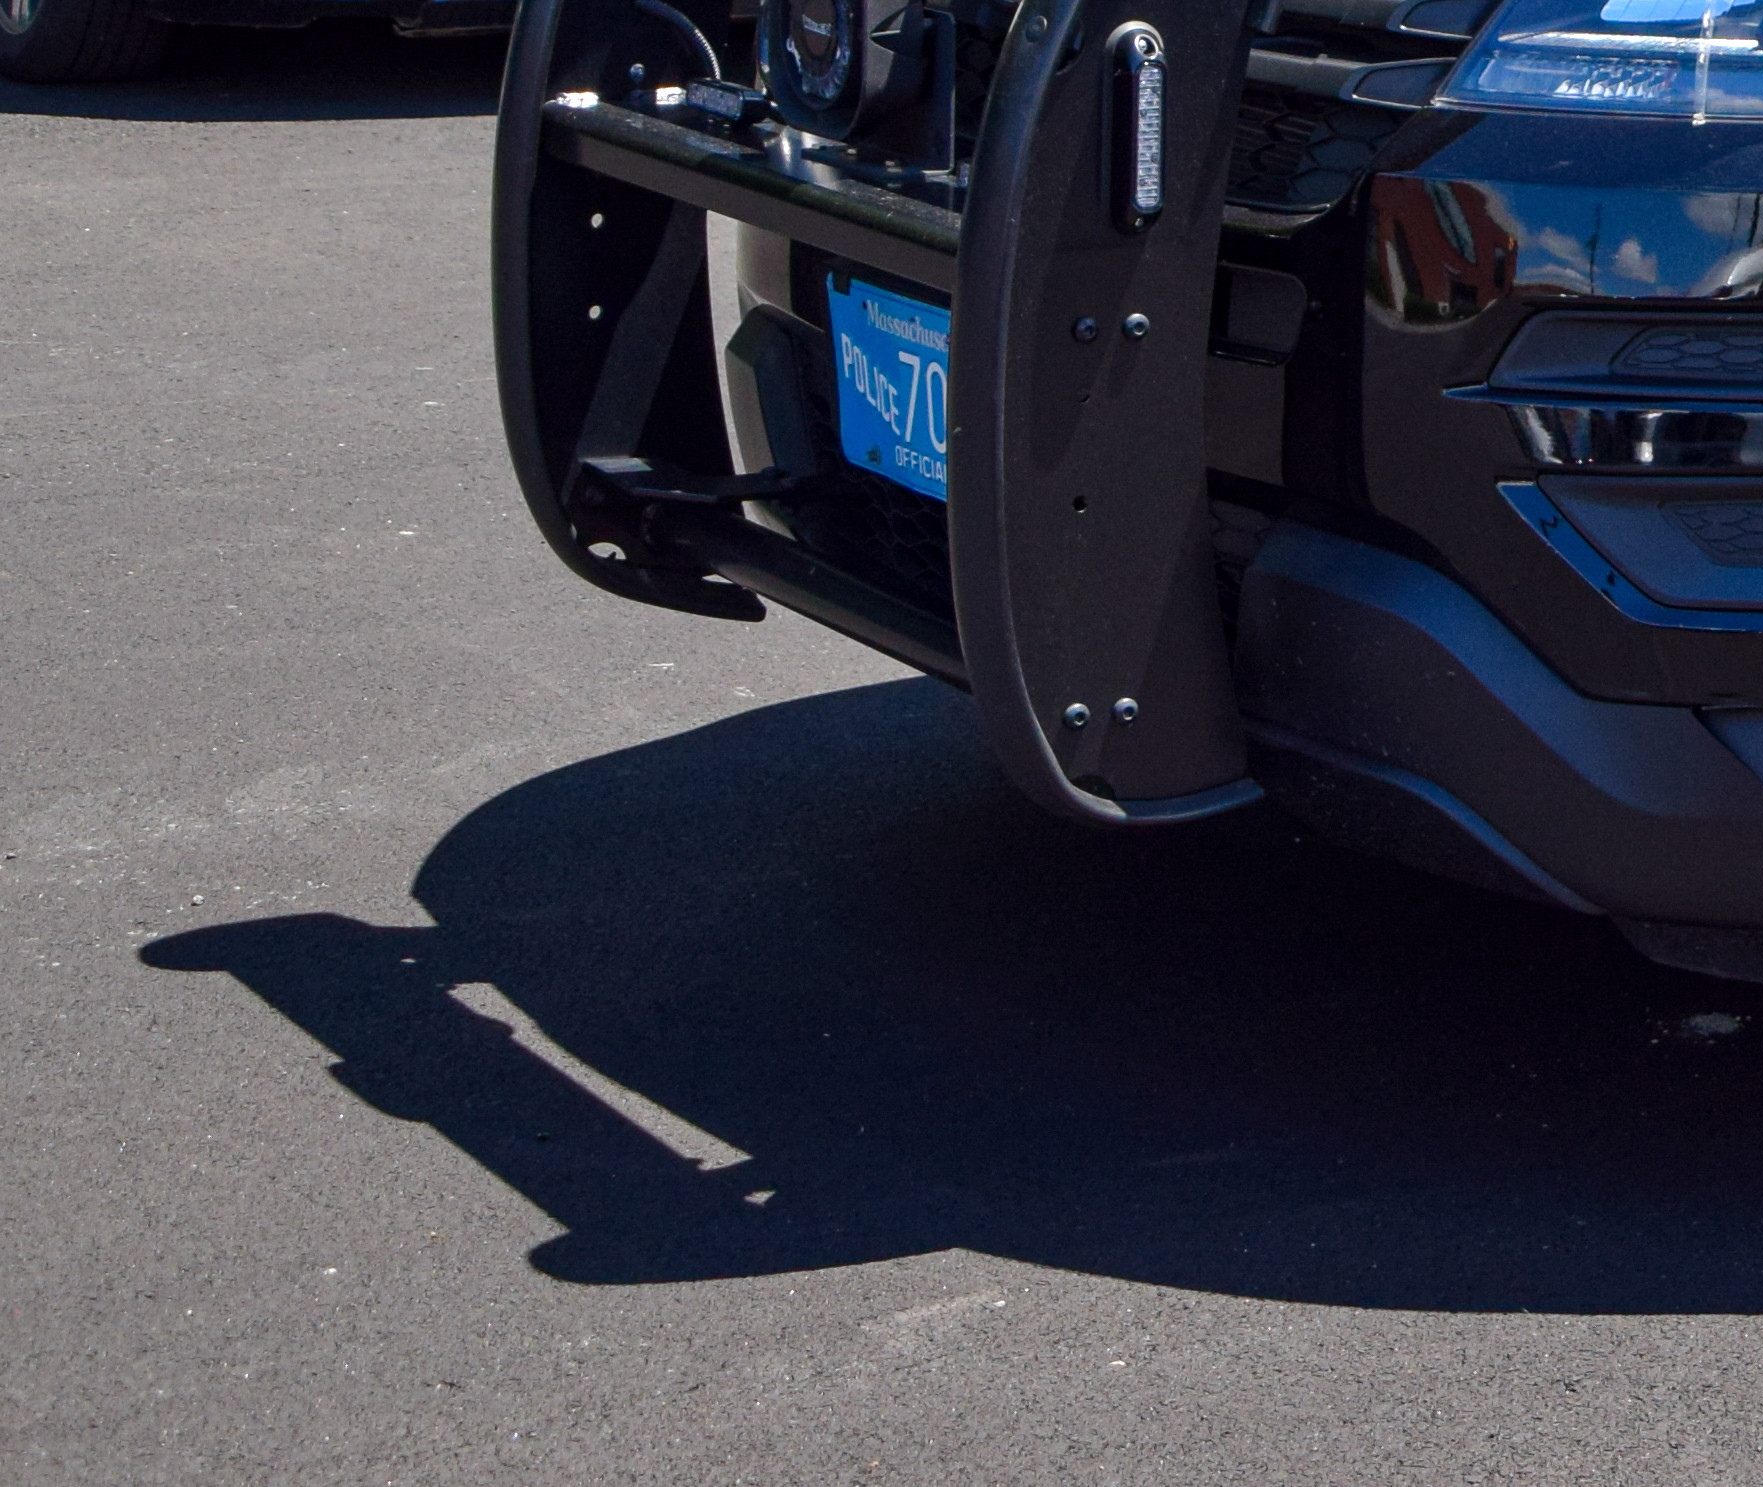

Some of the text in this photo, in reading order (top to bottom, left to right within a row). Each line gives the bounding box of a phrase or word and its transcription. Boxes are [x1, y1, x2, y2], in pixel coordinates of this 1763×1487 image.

[866, 299, 948, 353] Massachuse
[841, 331, 947, 455] POLICE 70
